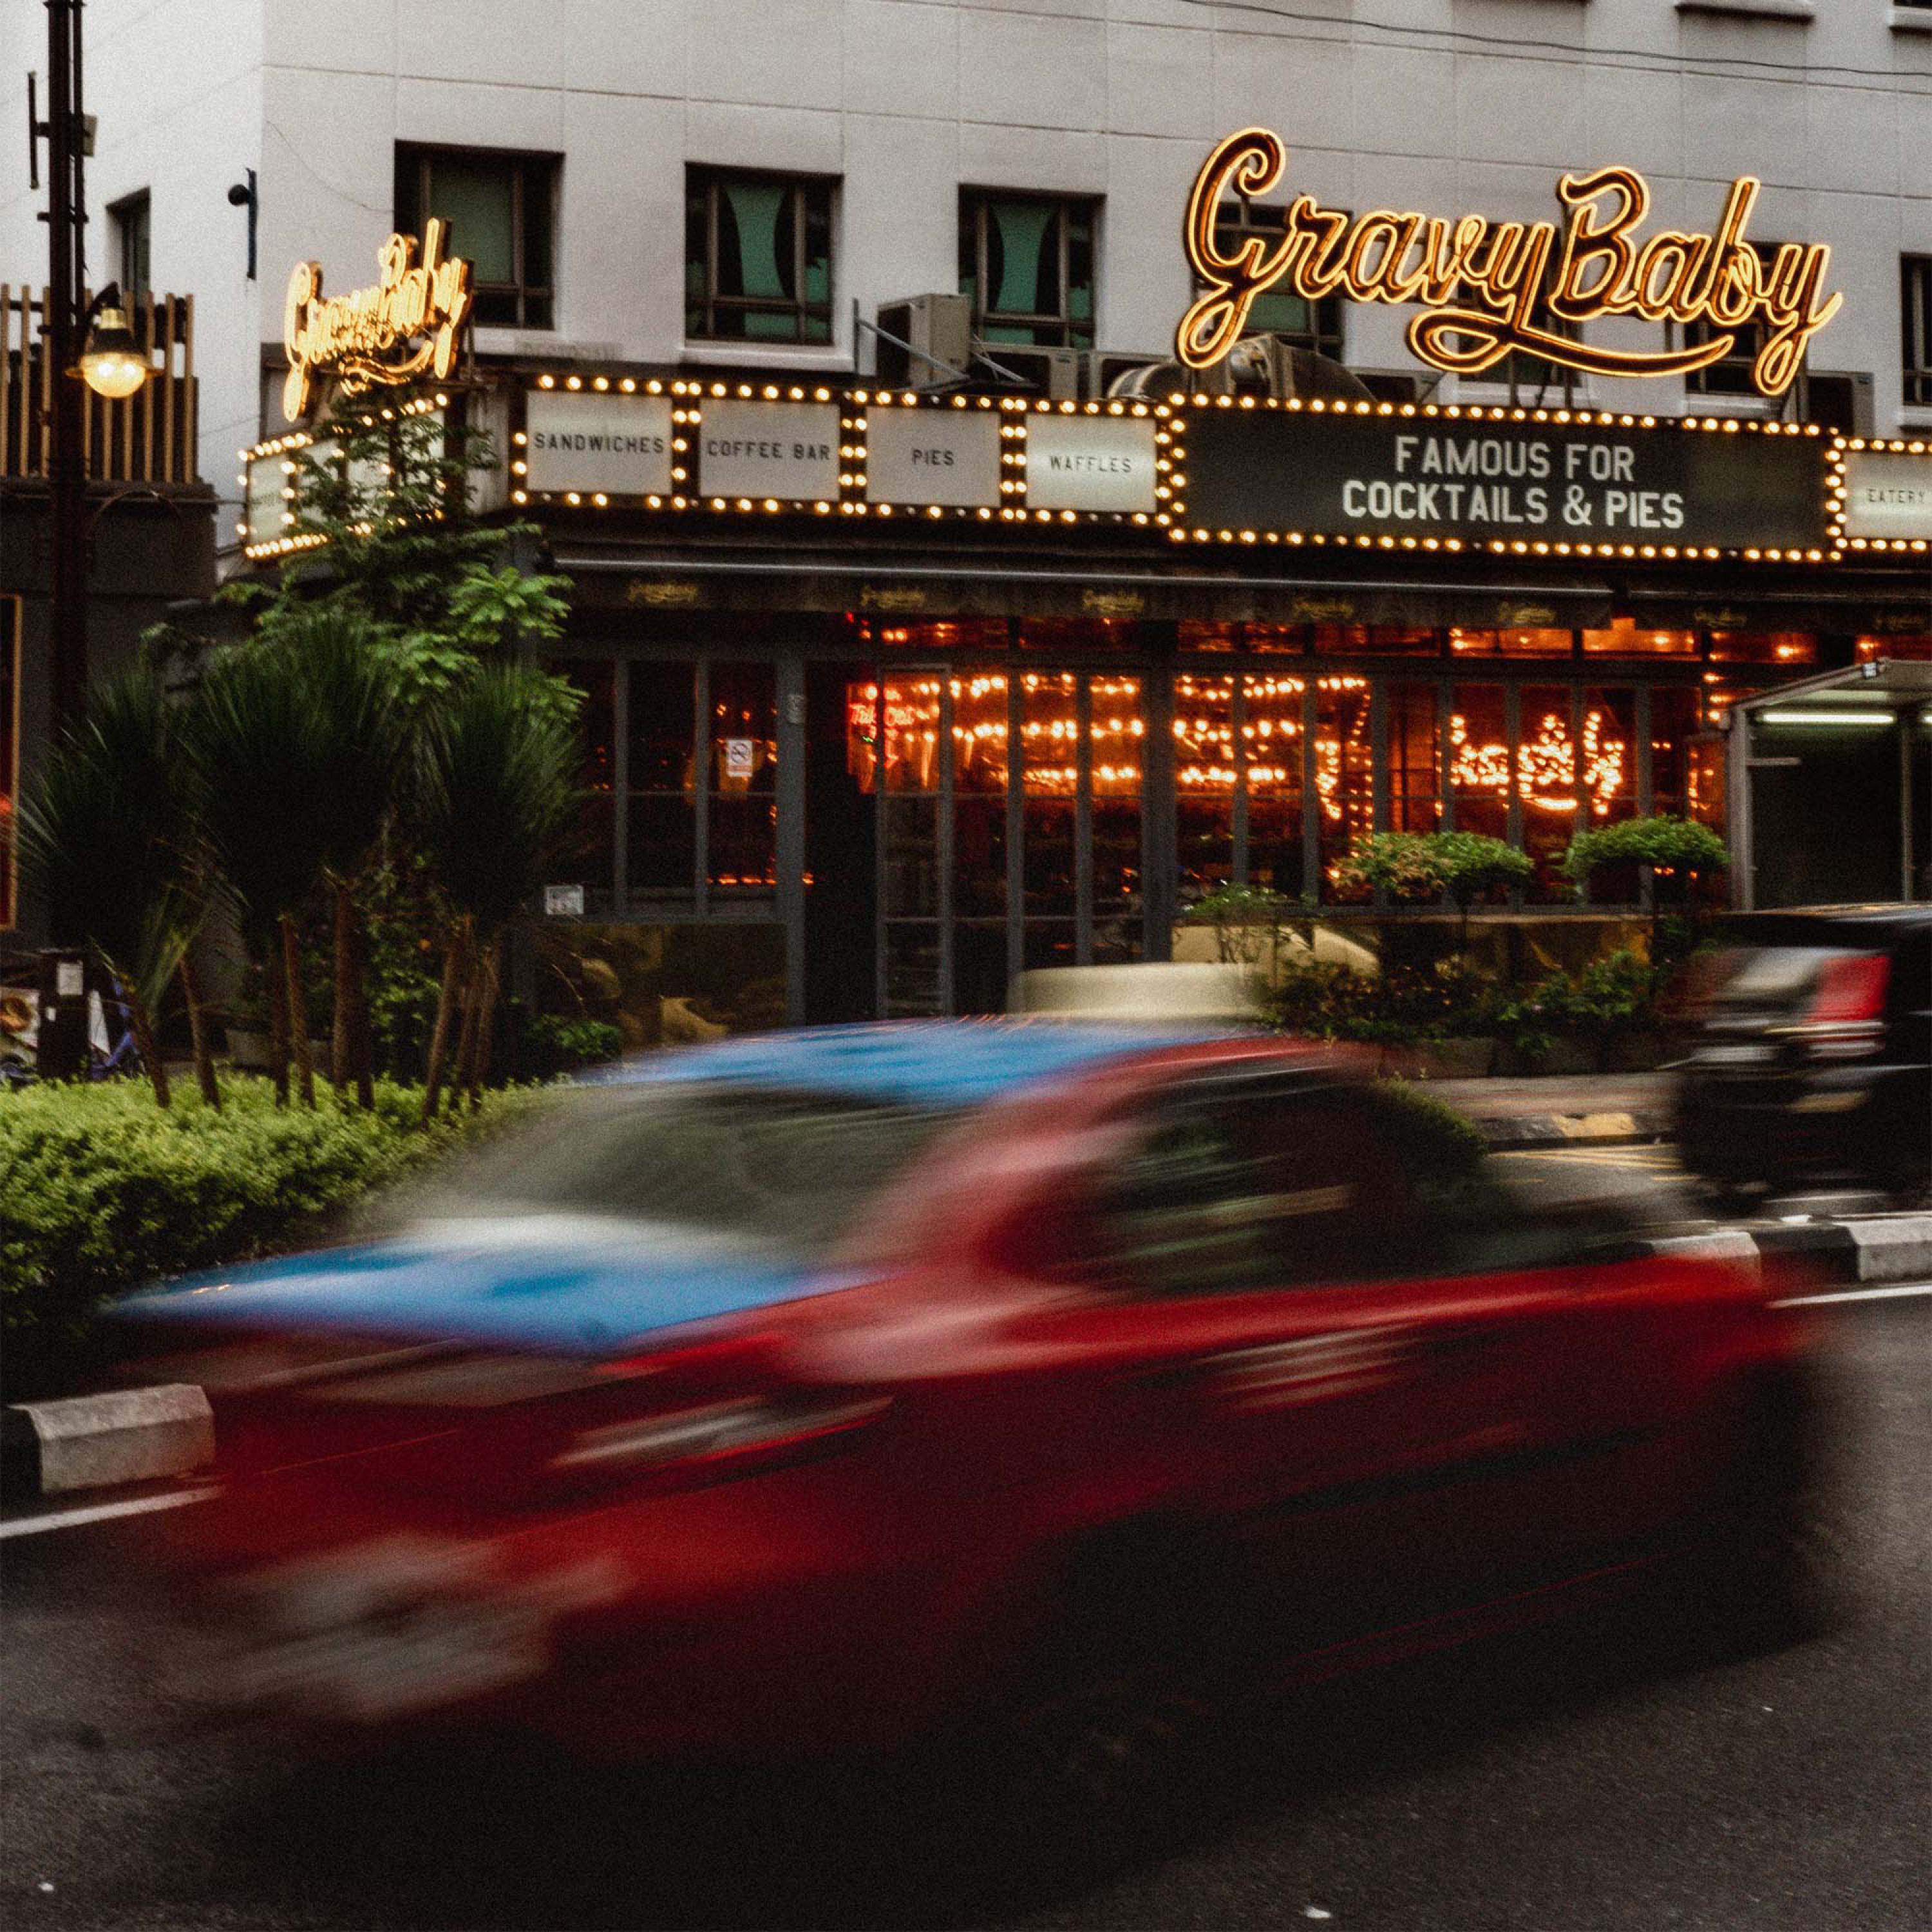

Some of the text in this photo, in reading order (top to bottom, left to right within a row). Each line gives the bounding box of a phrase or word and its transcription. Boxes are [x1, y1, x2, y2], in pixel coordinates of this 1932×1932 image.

[1175, 127, 1843, 395] Gravy Baby
[534, 431, 665, 454] SANDWICHES
[707, 439, 831, 461] COFFEE BAR
[911, 448, 955, 467] PIES
[1050, 454, 1132, 473] WAFFLES
[1395, 435, 1635, 482] FAMOUS FOR
[1342, 480, 1685, 529] COCKTAILS & PIES
[1868, 488, 1925, 504] EATERY
